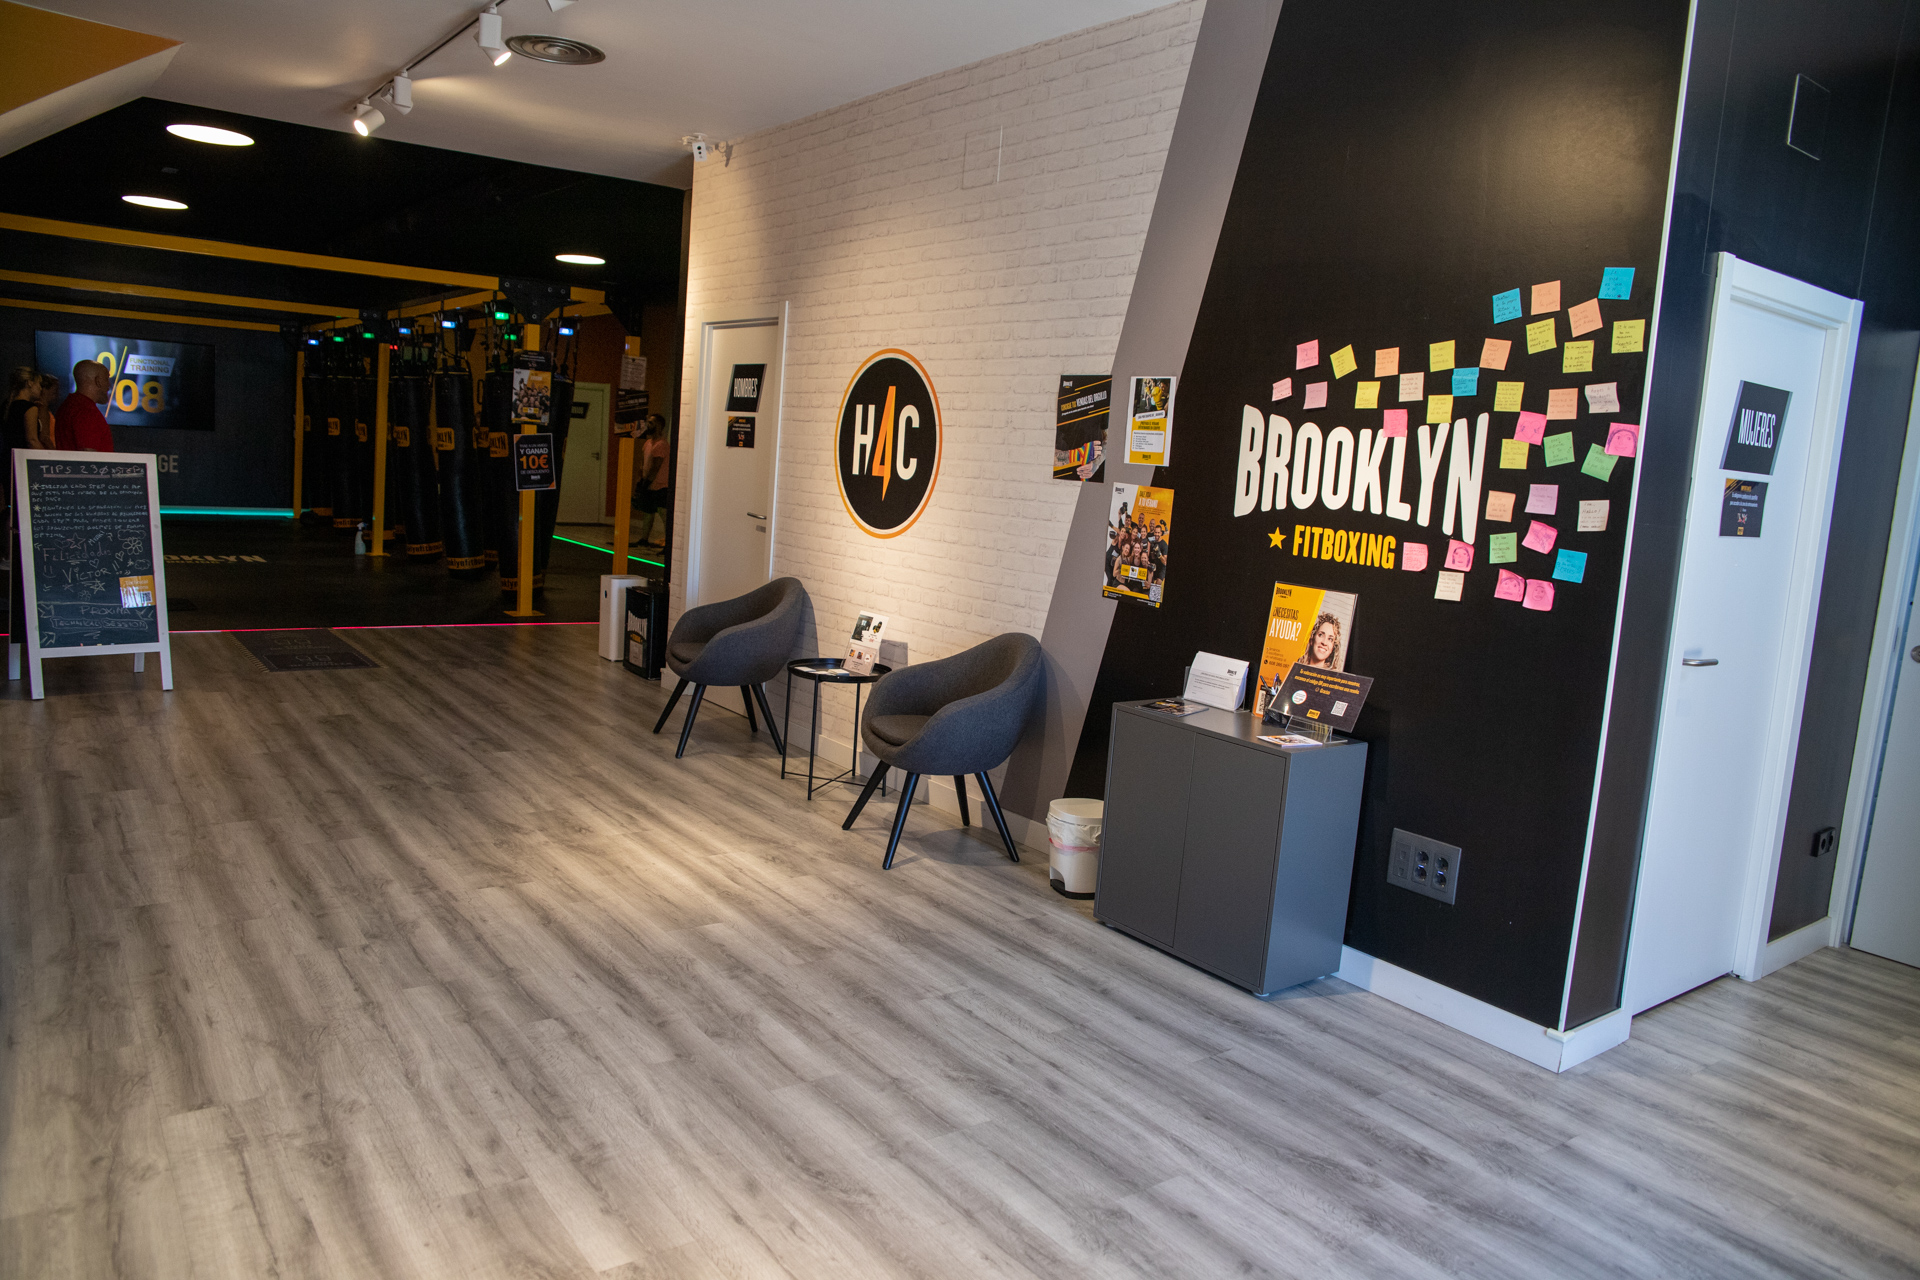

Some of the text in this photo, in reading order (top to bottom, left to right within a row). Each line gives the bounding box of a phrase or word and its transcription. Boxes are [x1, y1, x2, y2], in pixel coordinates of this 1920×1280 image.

[130, 358, 170, 366] FUNCTIONAL
[131, 365, 169, 373] TRAINING
[115, 379, 165, 413] 08
[733, 378, 758, 398] HOMBRES
[1738, 408, 1777, 449] MUJERES
[40, 465, 72, 474] TIPS
[158, 454, 179, 473] GE
[519, 454, 549, 469] 10€
[1233, 404, 1489, 545] BROOKLYN
[1292, 524, 1396, 569] FITBOXING
[1276, 587, 1292, 597] BROOKLYN
[1273, 607, 1299, 620] ¿NECESITAS
[1269, 618, 1302, 641] AYUDA?
